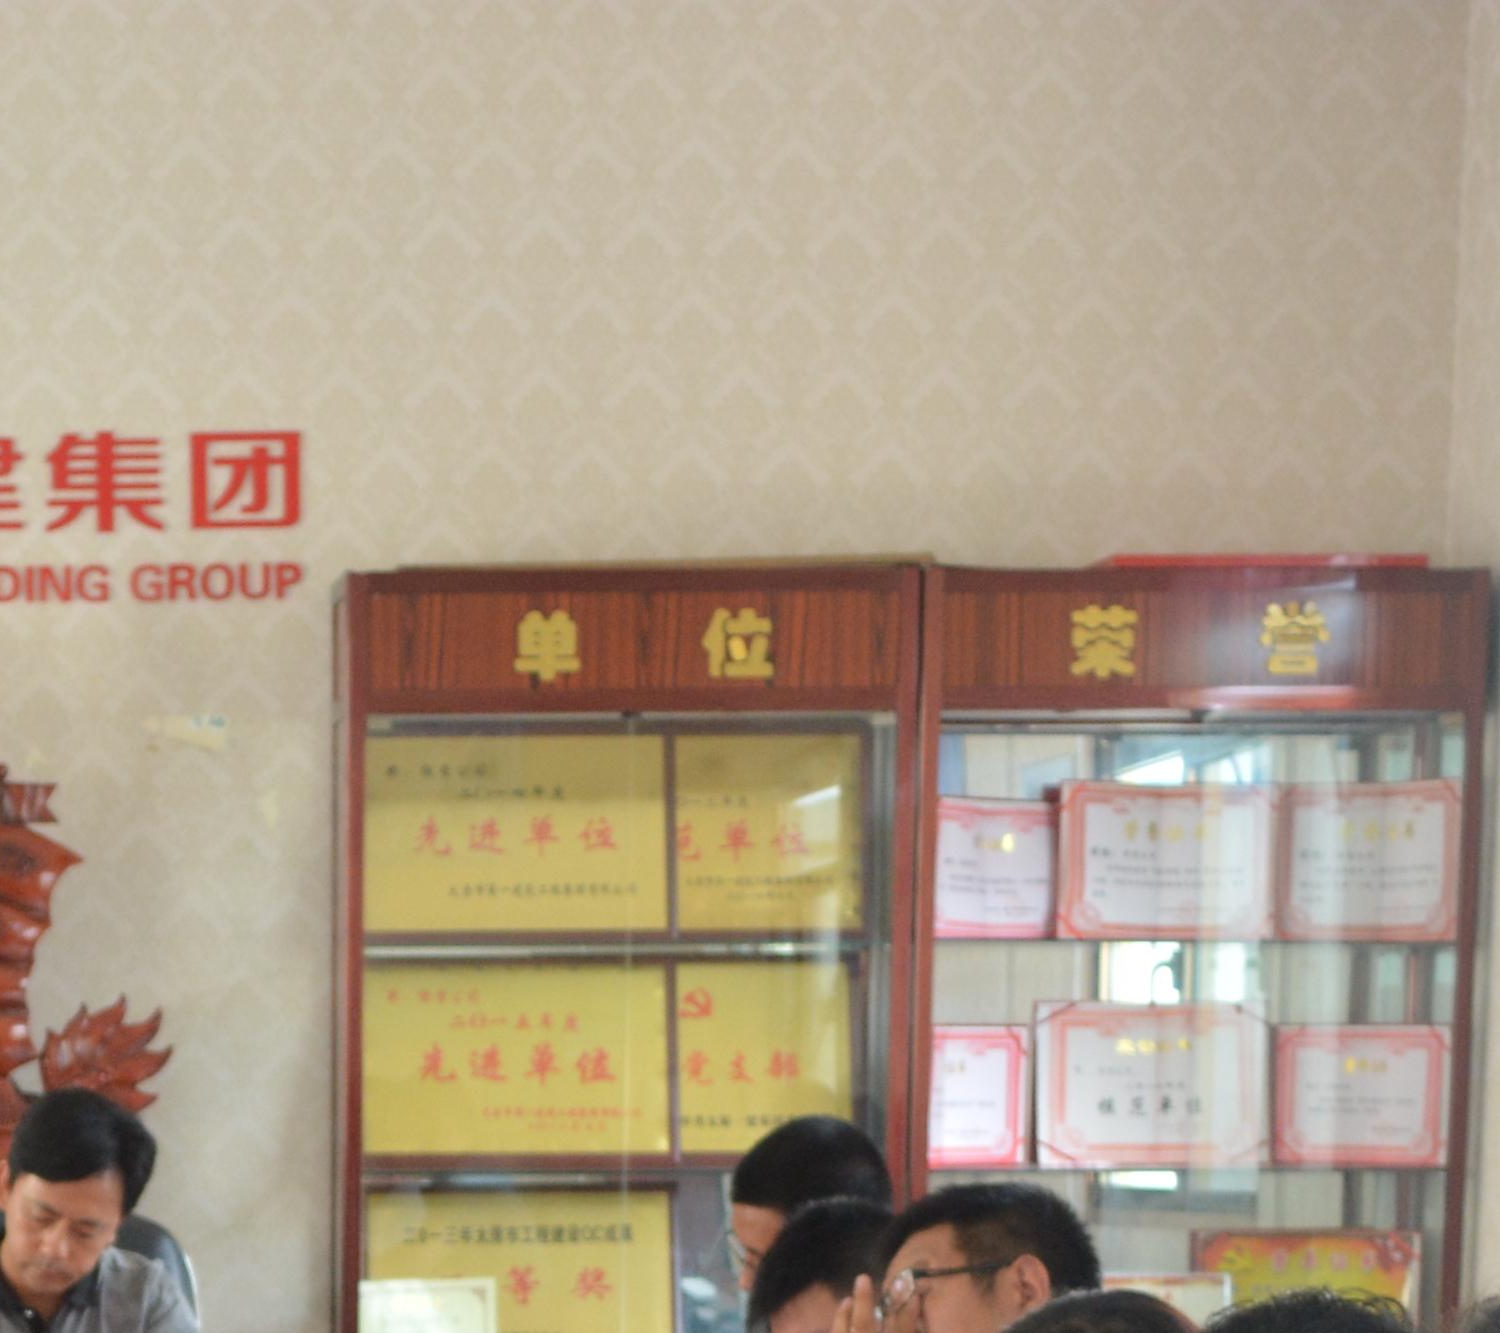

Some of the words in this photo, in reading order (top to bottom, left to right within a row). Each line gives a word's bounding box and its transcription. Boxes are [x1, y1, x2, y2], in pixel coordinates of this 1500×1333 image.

[130, 562, 304, 602] GROUP
[513, 607, 775, 682] 单位
[415, 815, 620, 859] 先进单位
[417, 1043, 619, 1086] 先进单位
